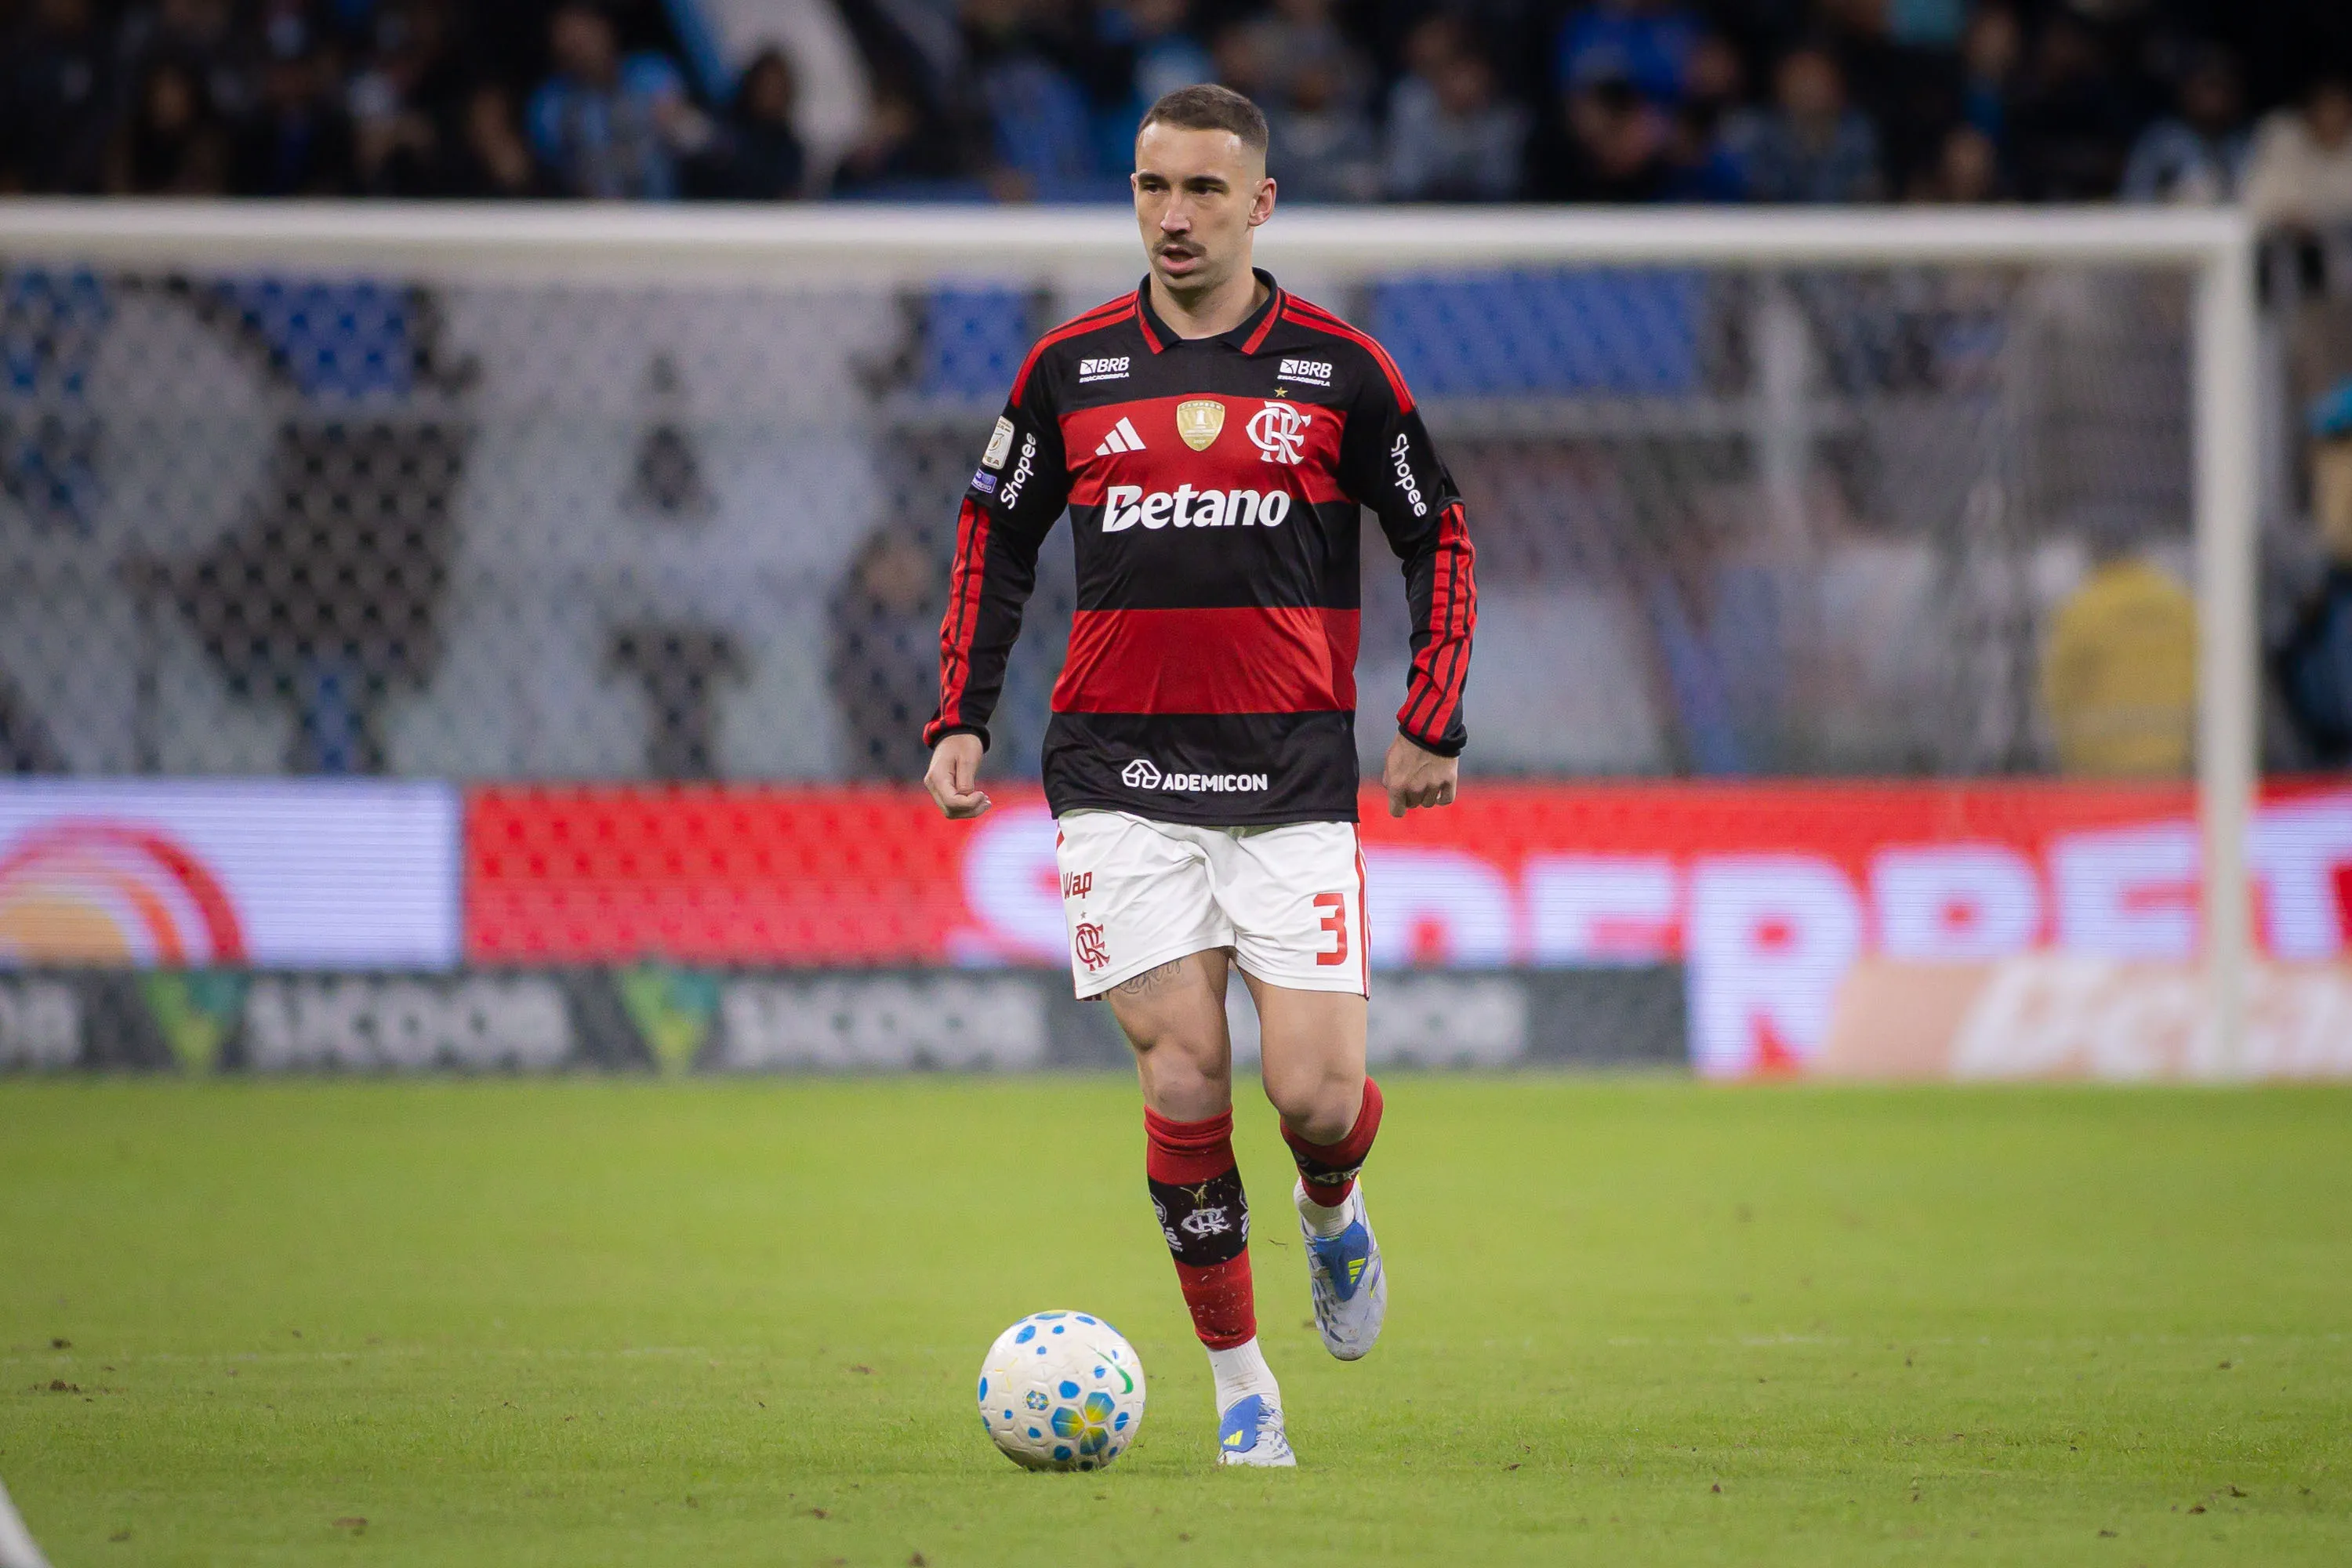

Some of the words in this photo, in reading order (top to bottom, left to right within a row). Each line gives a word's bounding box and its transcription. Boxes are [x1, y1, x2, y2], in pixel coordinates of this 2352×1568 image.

[1096, 357, 1130, 372] BRB
[1298, 360, 1333, 379] BRB
[1000, 433, 1036, 510] Shopee
[1391, 433, 1427, 517] Shopee
[1102, 483, 1291, 532] Betano
[1162, 774, 1268, 792] ADEMICON
[1063, 871, 1092, 899] Wap
[1313, 893, 1348, 965] 3
